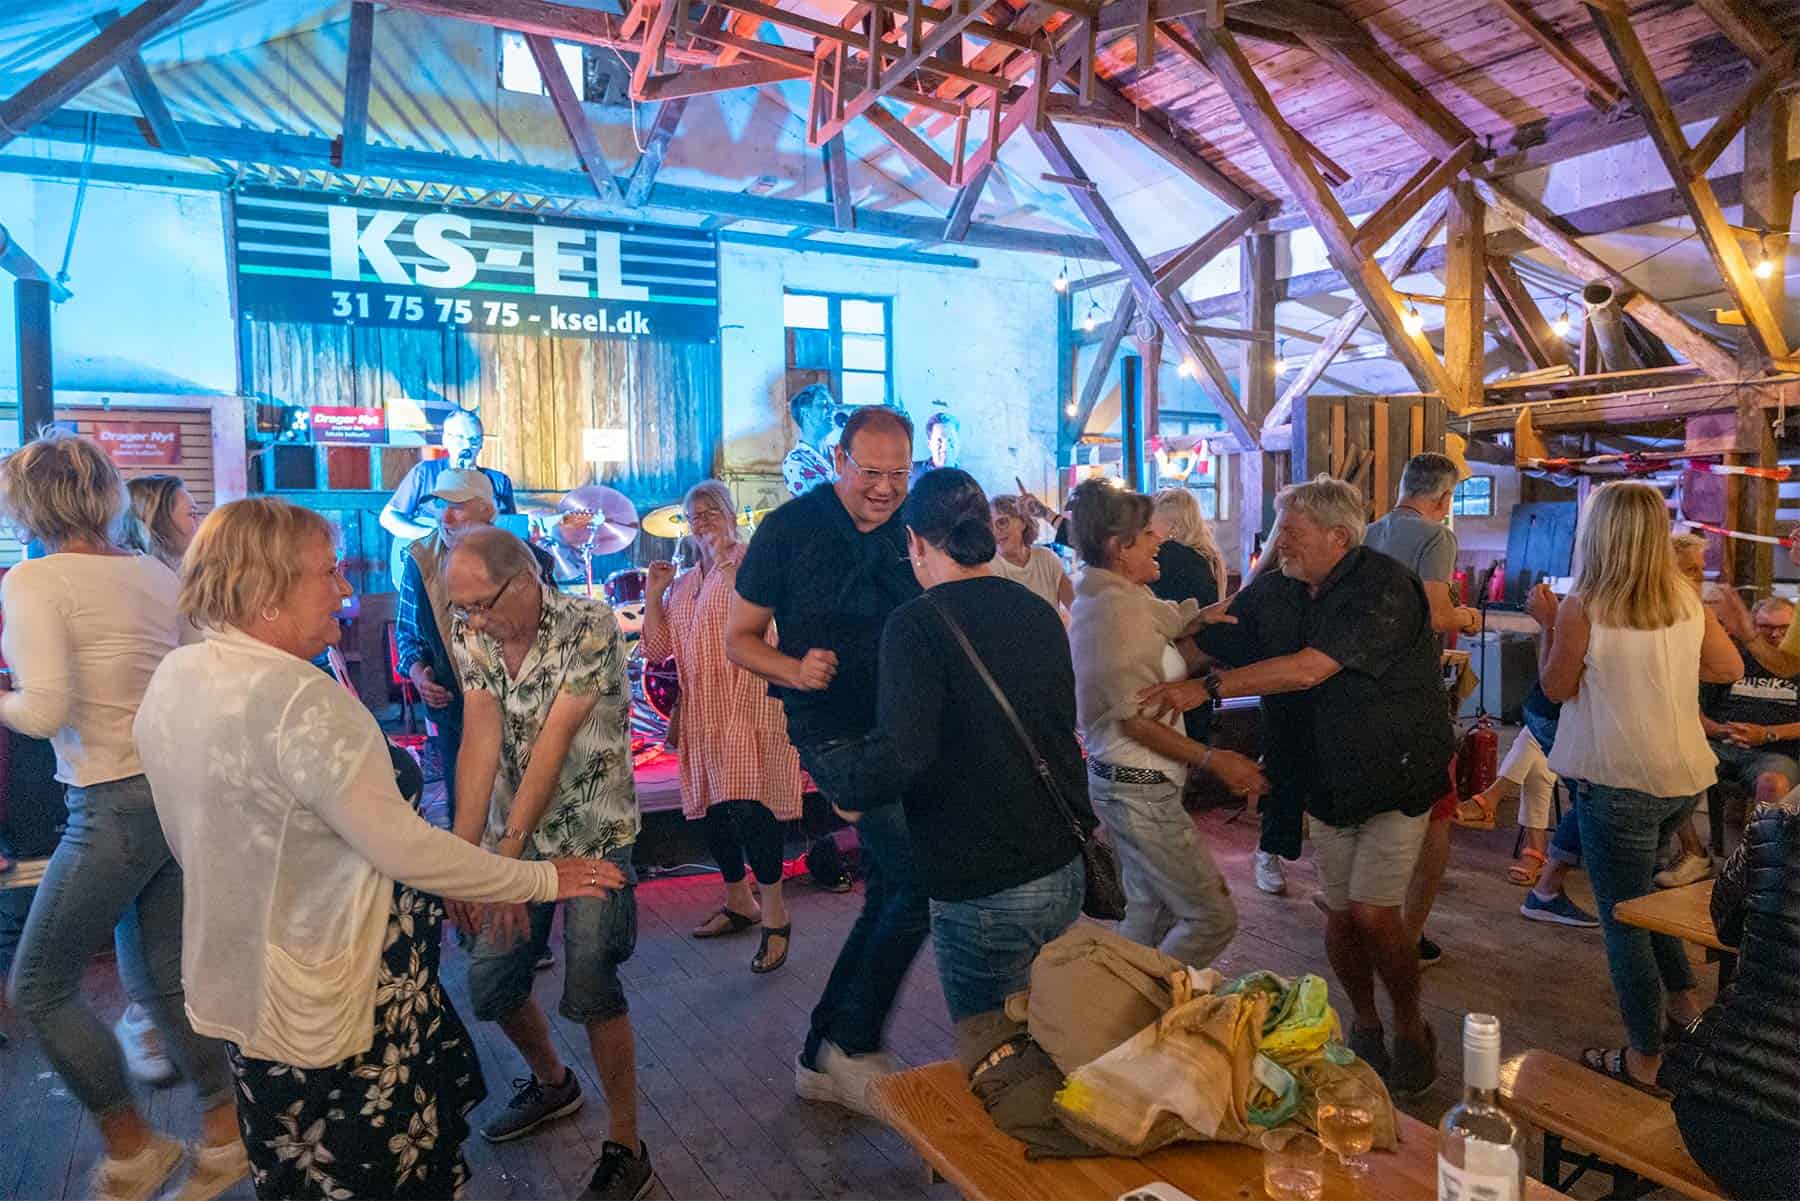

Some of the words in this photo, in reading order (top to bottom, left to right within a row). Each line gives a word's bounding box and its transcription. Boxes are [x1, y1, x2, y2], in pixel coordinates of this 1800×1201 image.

[327, 205, 649, 301] KS-EL
[331, 291, 370, 318] 31
[384, 294, 425, 321] 75
[434, 298, 473, 324] 75
[482, 301, 520, 327] 75
[550, 305, 650, 334] ksel.dk
